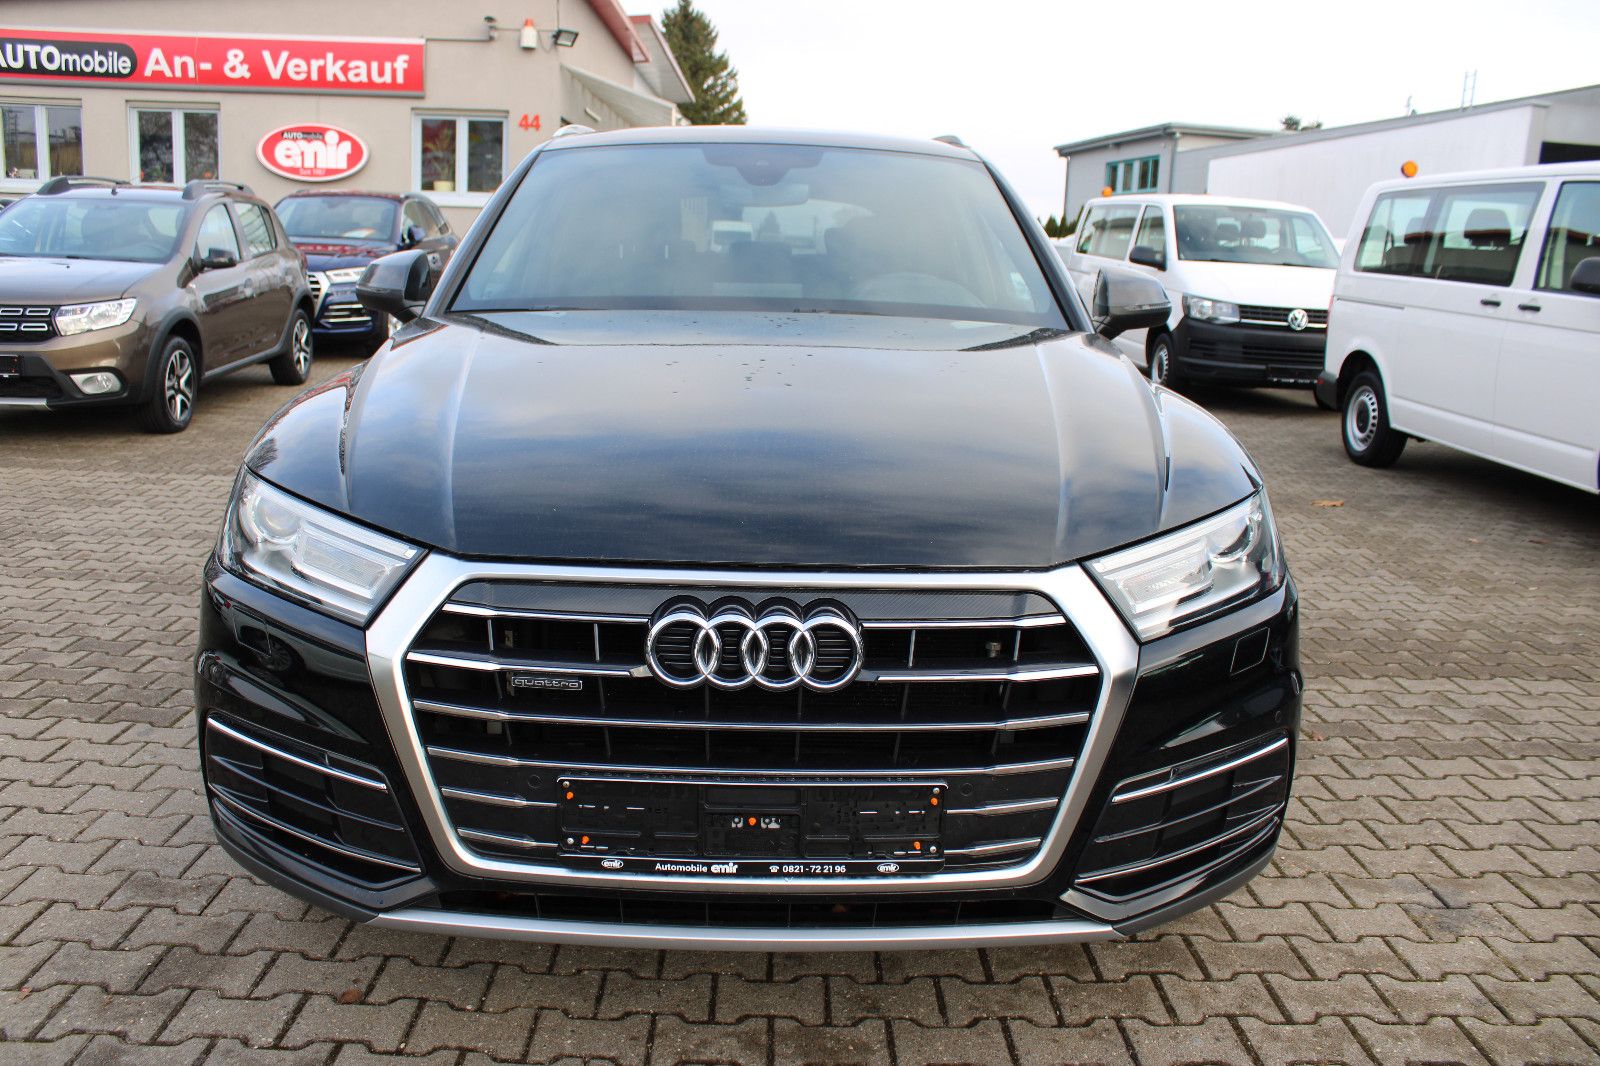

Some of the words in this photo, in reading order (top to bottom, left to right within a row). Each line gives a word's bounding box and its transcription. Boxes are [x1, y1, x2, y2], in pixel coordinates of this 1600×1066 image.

[144, 48, 212, 78] An-
[223, 48, 251, 79] &
[262, 50, 410, 84] Verkauf
[518, 114, 541, 131] 44
[274, 129, 352, 169] emir
[514, 679, 579, 688] quattro
[655, 863, 708, 872] Automobile
[710, 862, 738, 873] emir
